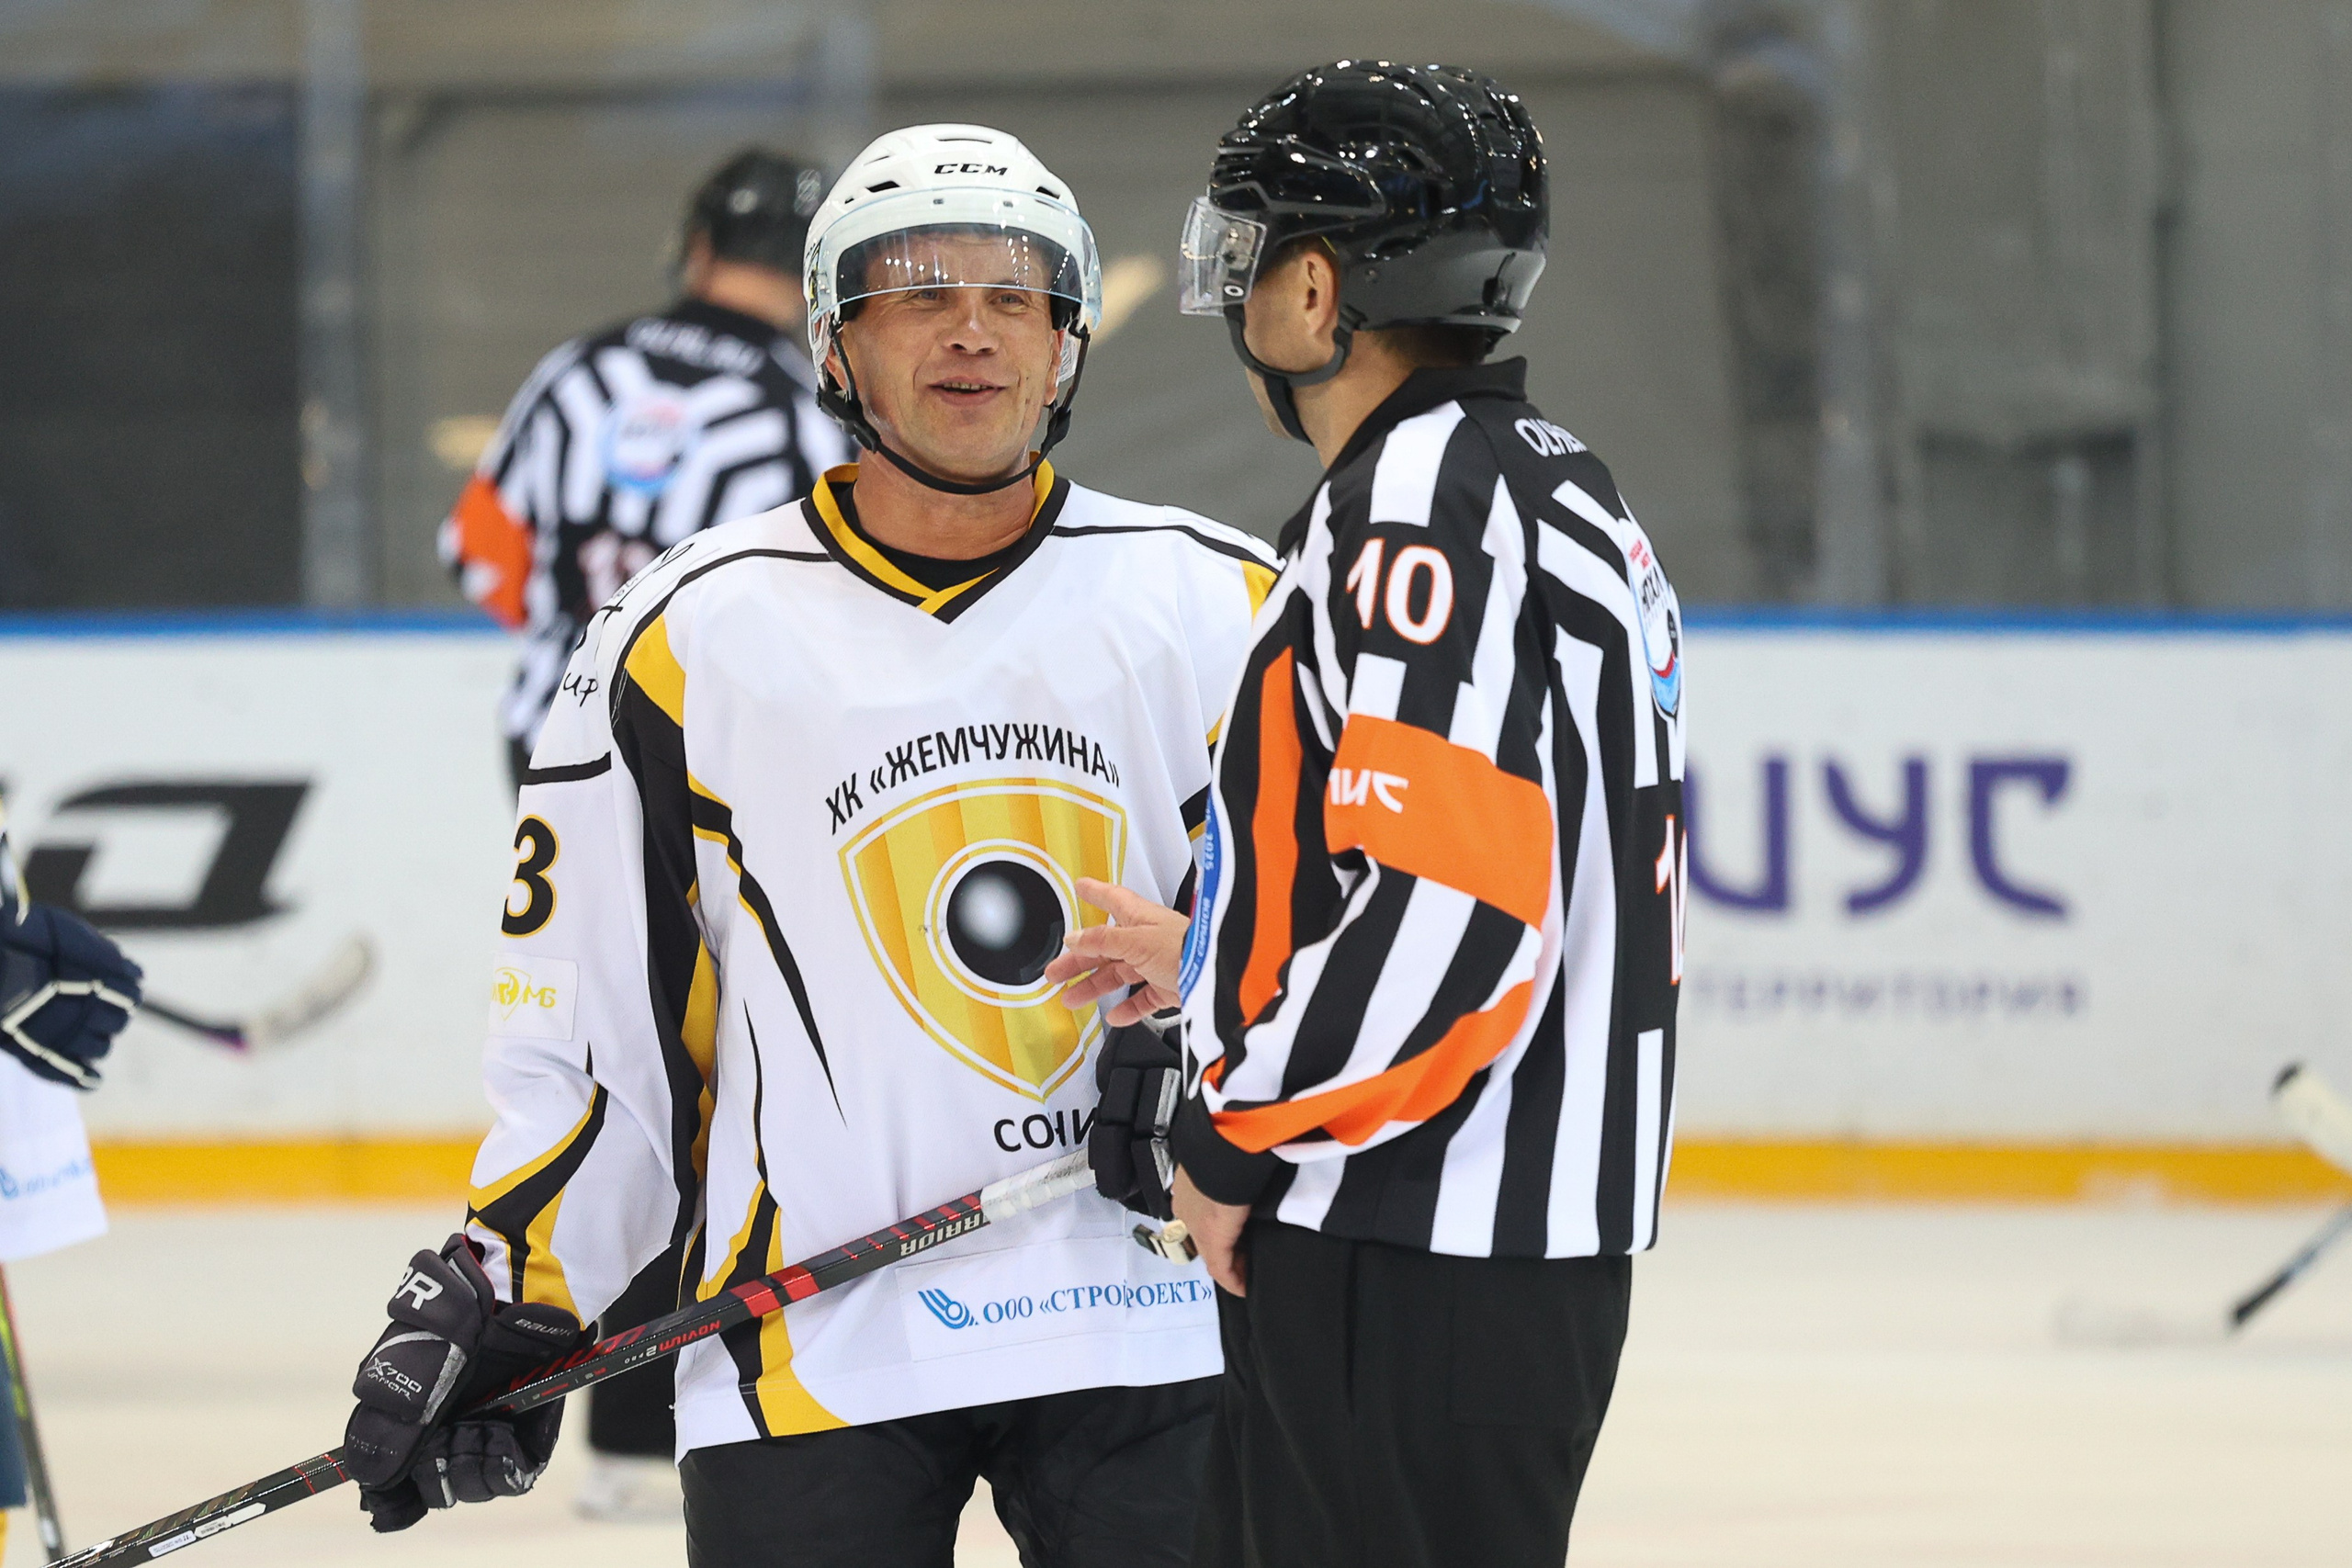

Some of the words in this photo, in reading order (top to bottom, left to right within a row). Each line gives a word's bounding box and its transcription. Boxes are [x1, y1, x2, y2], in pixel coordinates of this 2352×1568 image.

[933, 163, 1009, 176] CCM
[1346, 536, 1455, 645] 10
[825, 773, 864, 835] ХК
[869, 722, 1121, 795] «ЖЕМЧУЖИНА»
[1684, 753, 2074, 919] ИУС
[899, 1211, 985, 1258] RRIOR
[983, 1295, 1033, 1324] ООО
[659, 1319, 721, 1353] NOVIUM
